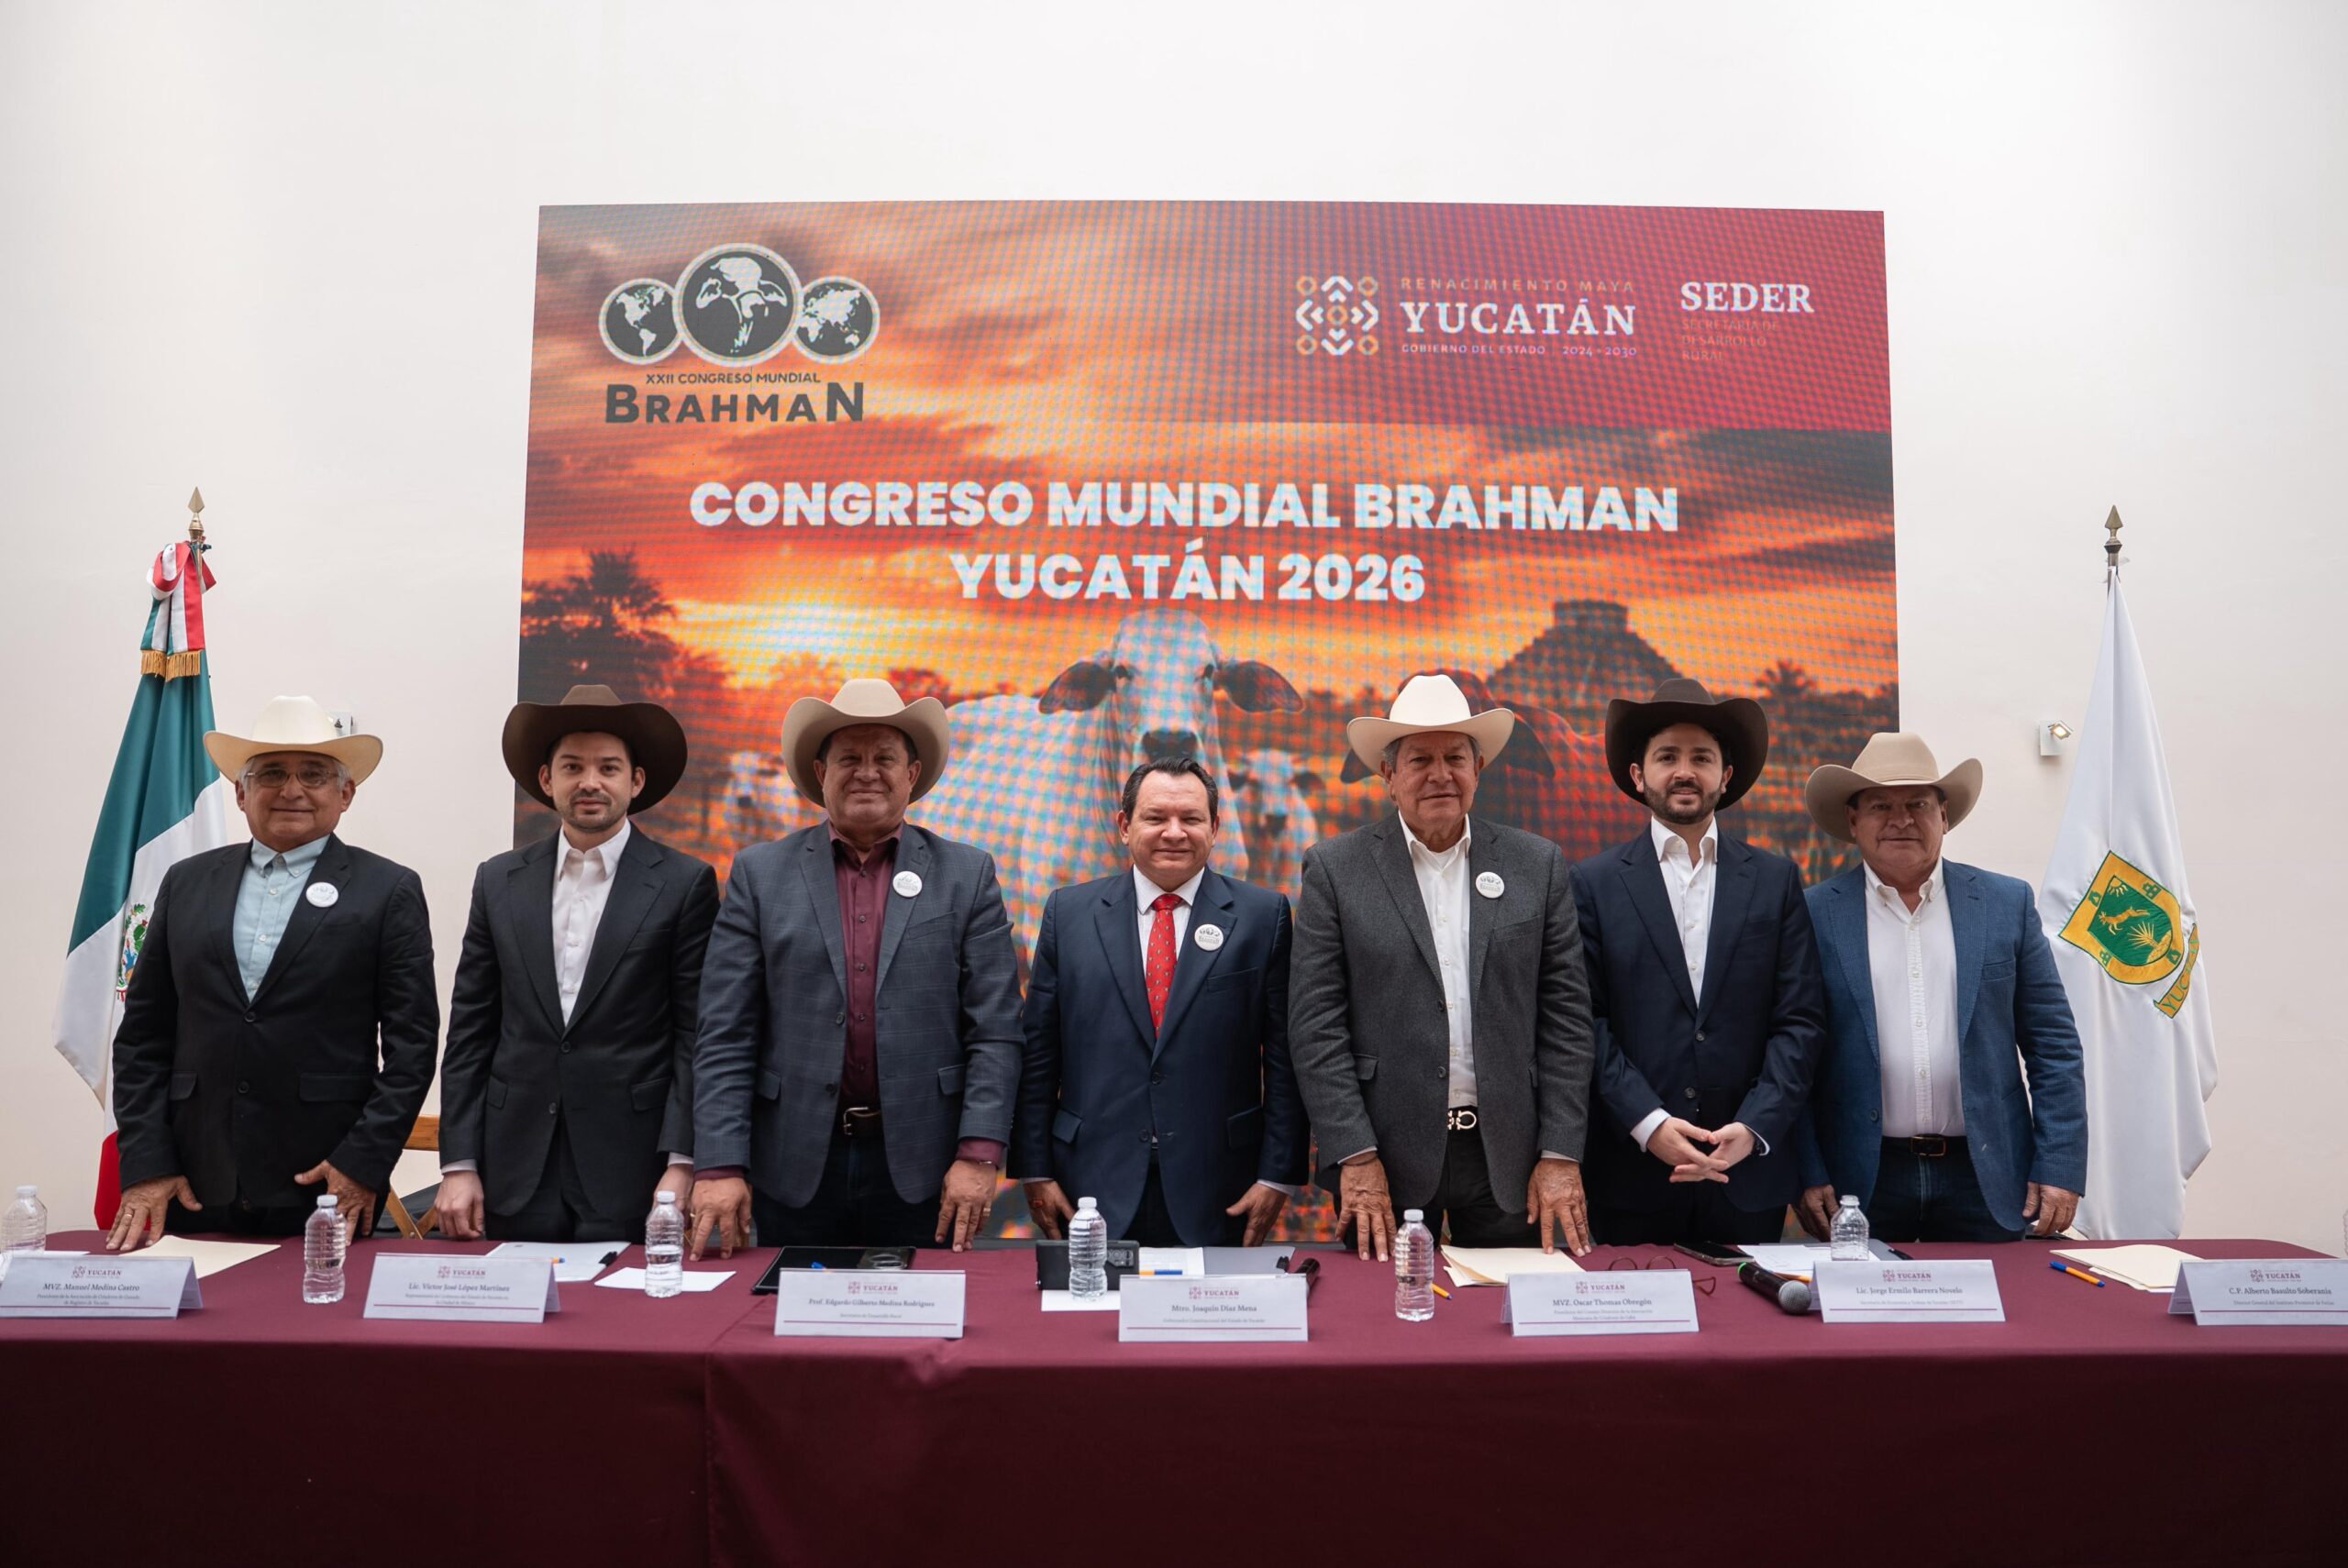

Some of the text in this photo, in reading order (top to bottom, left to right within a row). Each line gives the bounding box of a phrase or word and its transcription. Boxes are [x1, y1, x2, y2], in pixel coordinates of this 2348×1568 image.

[1401, 278, 1634, 293] RENACIMIENTO MAYA
[1680, 282, 1815, 314] SEDER
[1399, 298, 1636, 336] YUCATÁN
[1401, 344, 1468, 354] GOBIERNO
[1471, 344, 1494, 354] DEL
[1499, 345, 1545, 355] ESTADO
[1562, 346, 1593, 358] 2024
[1605, 347, 1637, 359] 2030
[646, 372, 822, 384] XXII CONGRESO MUNDIAL
[605, 381, 864, 423] BRAHMAN
[689, 480, 1678, 532] CONGRESO MUNDIAL BRAHMAN
[948, 537, 1425, 602] YUCATÁN 2026
[63, 1283, 91, 1291] Manuel
[1855, 1286, 1869, 1295] Lic.
[1869, 1286, 1888, 1295] Jorge
[2244, 1286, 2270, 1295] Alberto
